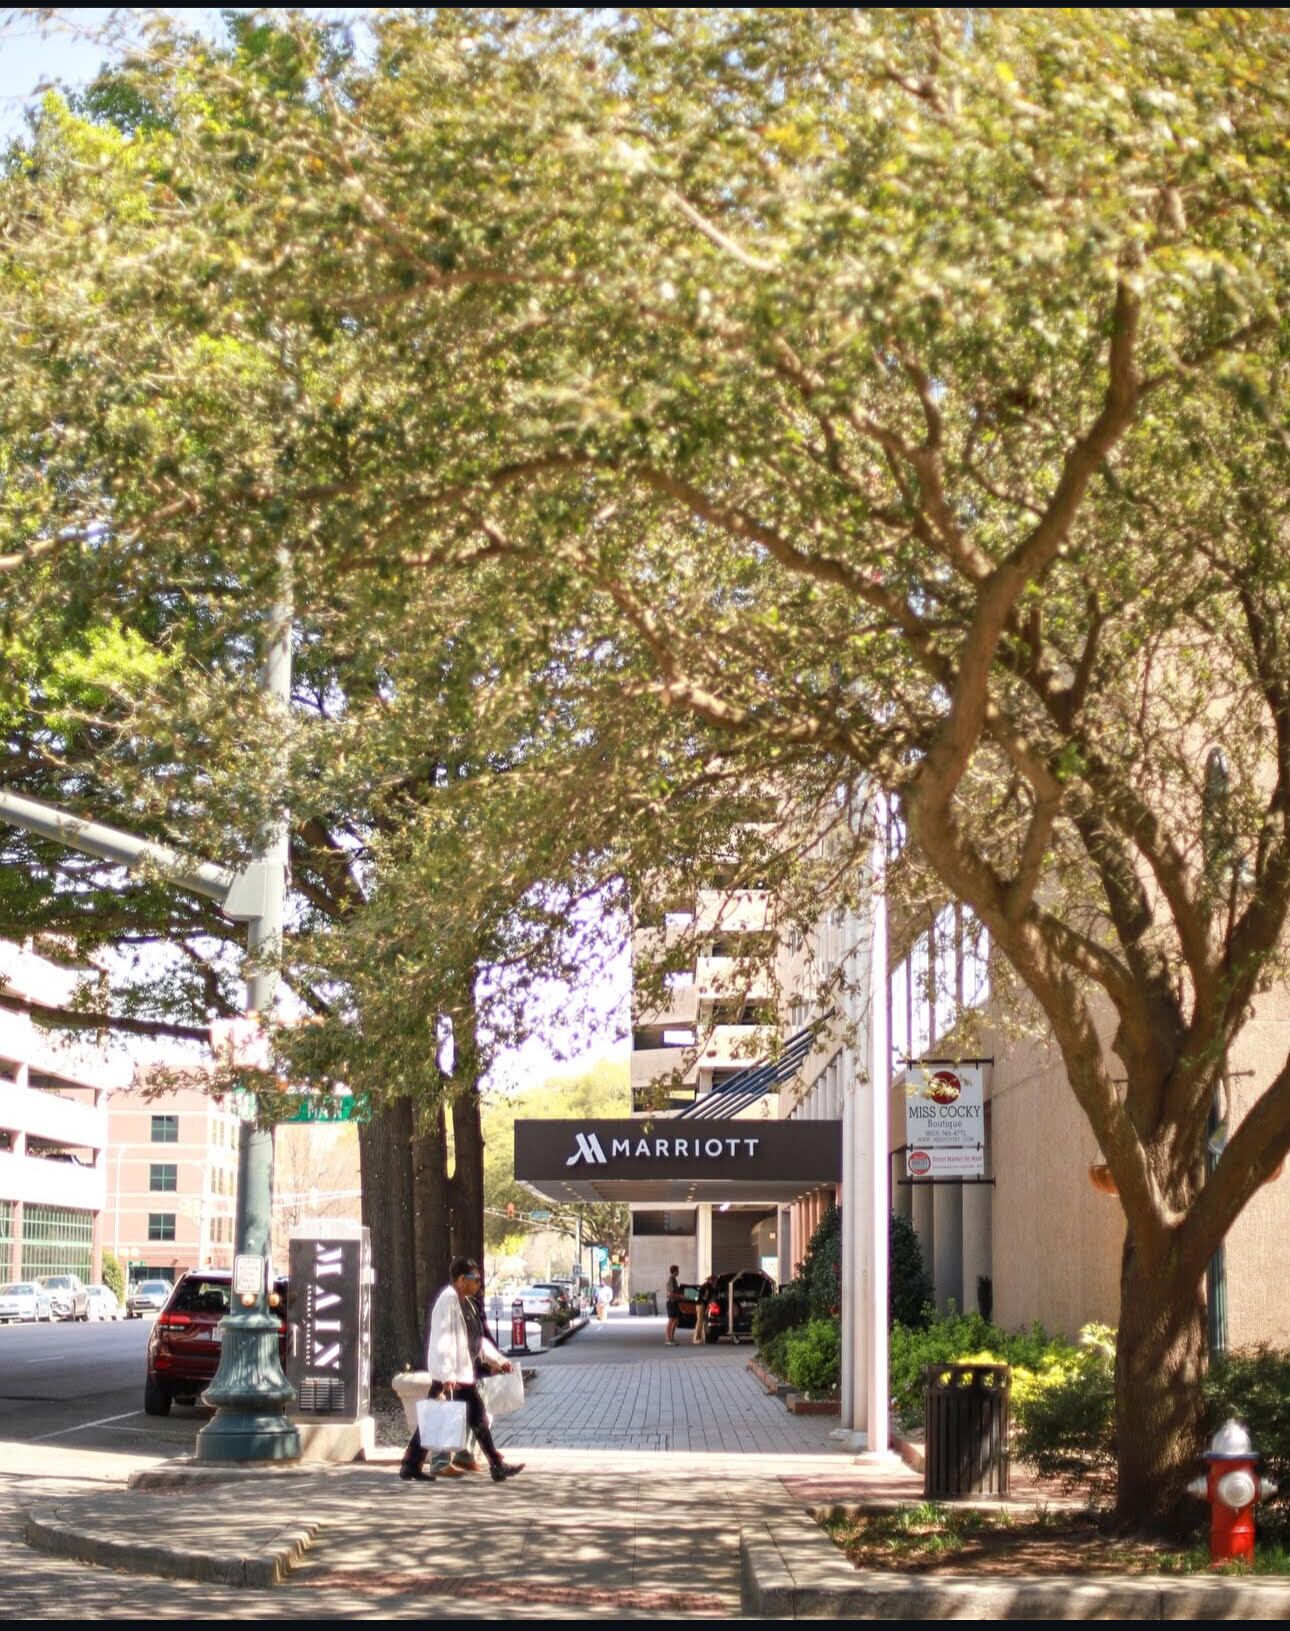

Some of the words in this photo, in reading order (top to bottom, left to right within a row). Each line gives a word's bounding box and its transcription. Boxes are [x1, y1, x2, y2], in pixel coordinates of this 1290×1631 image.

[909, 1106, 936, 1118] MISS
[939, 1105, 981, 1118] COCKY
[927, 1120, 962, 1129] Boutique
[612, 1138, 759, 1157] MARRIOTT
[314, 1242, 343, 1370] MAIN
